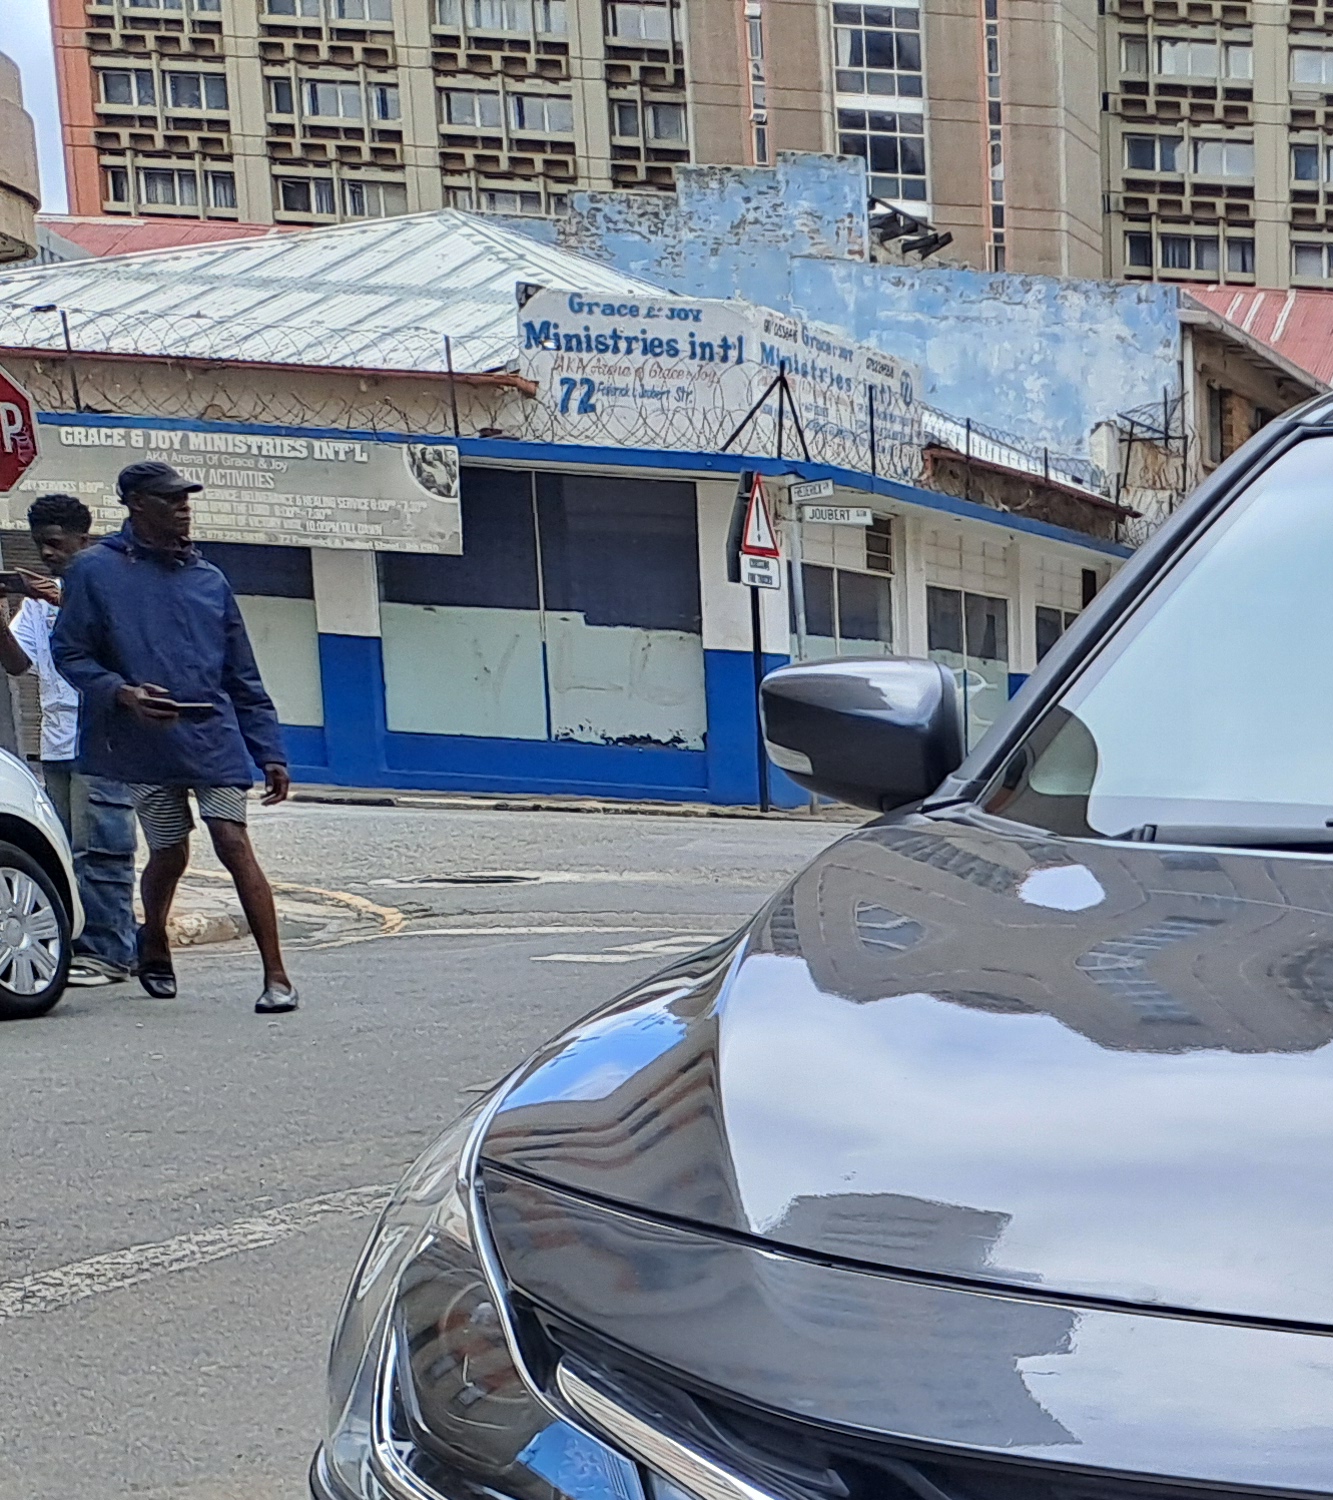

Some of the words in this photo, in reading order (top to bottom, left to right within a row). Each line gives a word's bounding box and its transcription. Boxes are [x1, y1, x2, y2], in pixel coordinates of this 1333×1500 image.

[568, 292, 640, 318] Grace
[522, 320, 681, 359] Ministries
[559, 377, 597, 416] 72
[60, 426, 127, 448] GRACE
[129, 429, 144, 449] &
[148, 430, 183, 450] JOY
[187, 431, 309, 459] MINISTRIES
[312, 440, 369, 463] INT'L
[145, 450, 169, 461] AKA
[171, 451, 204, 465] Arena
[221, 454, 255, 468] Grace
[269, 458, 288, 473] Joy
[208, 468, 275, 489] ACTIVITIES
[809, 507, 851, 521] JOUBERT
